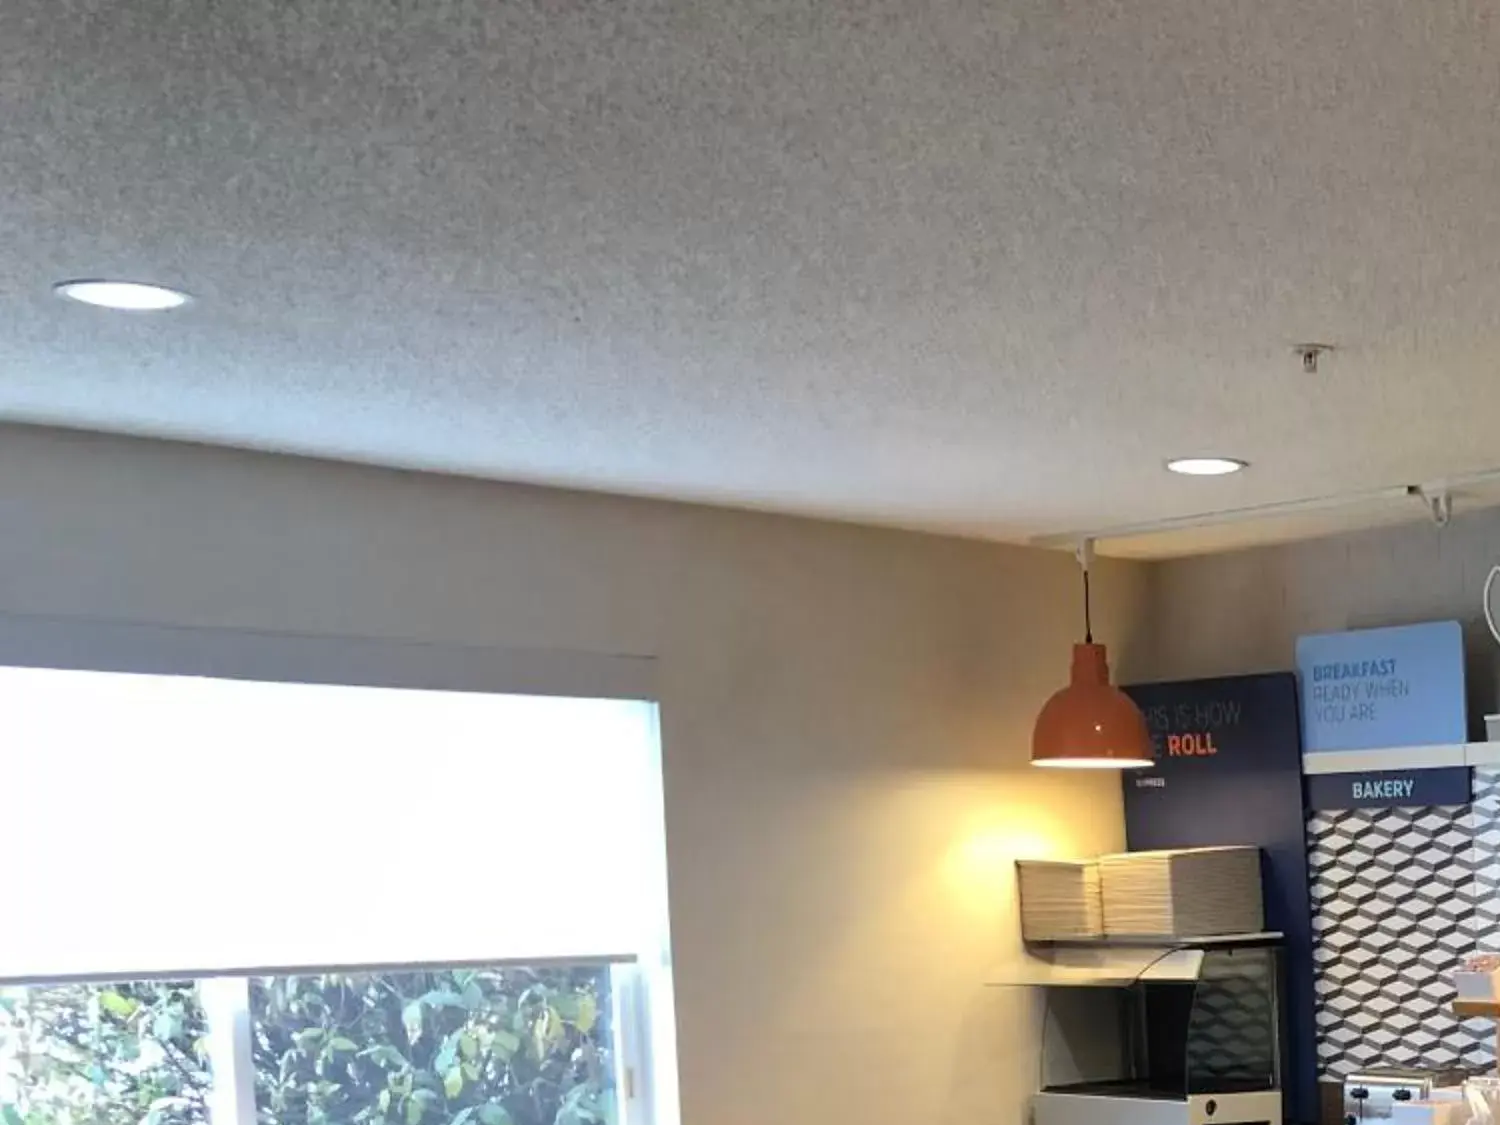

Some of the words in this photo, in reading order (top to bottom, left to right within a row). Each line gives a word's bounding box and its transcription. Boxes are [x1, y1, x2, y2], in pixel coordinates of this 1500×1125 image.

[1313, 658, 1396, 682] BREAKFAST
[1313, 681, 1359, 702] READY
[1365, 678, 1410, 700] WHEN
[1194, 700, 1241, 729] HOW
[1315, 702, 1346, 723] YOU
[1350, 701, 1378, 722] ARE
[1167, 731, 1218, 757] ROLL
[1352, 779, 1414, 799] BAKERY
